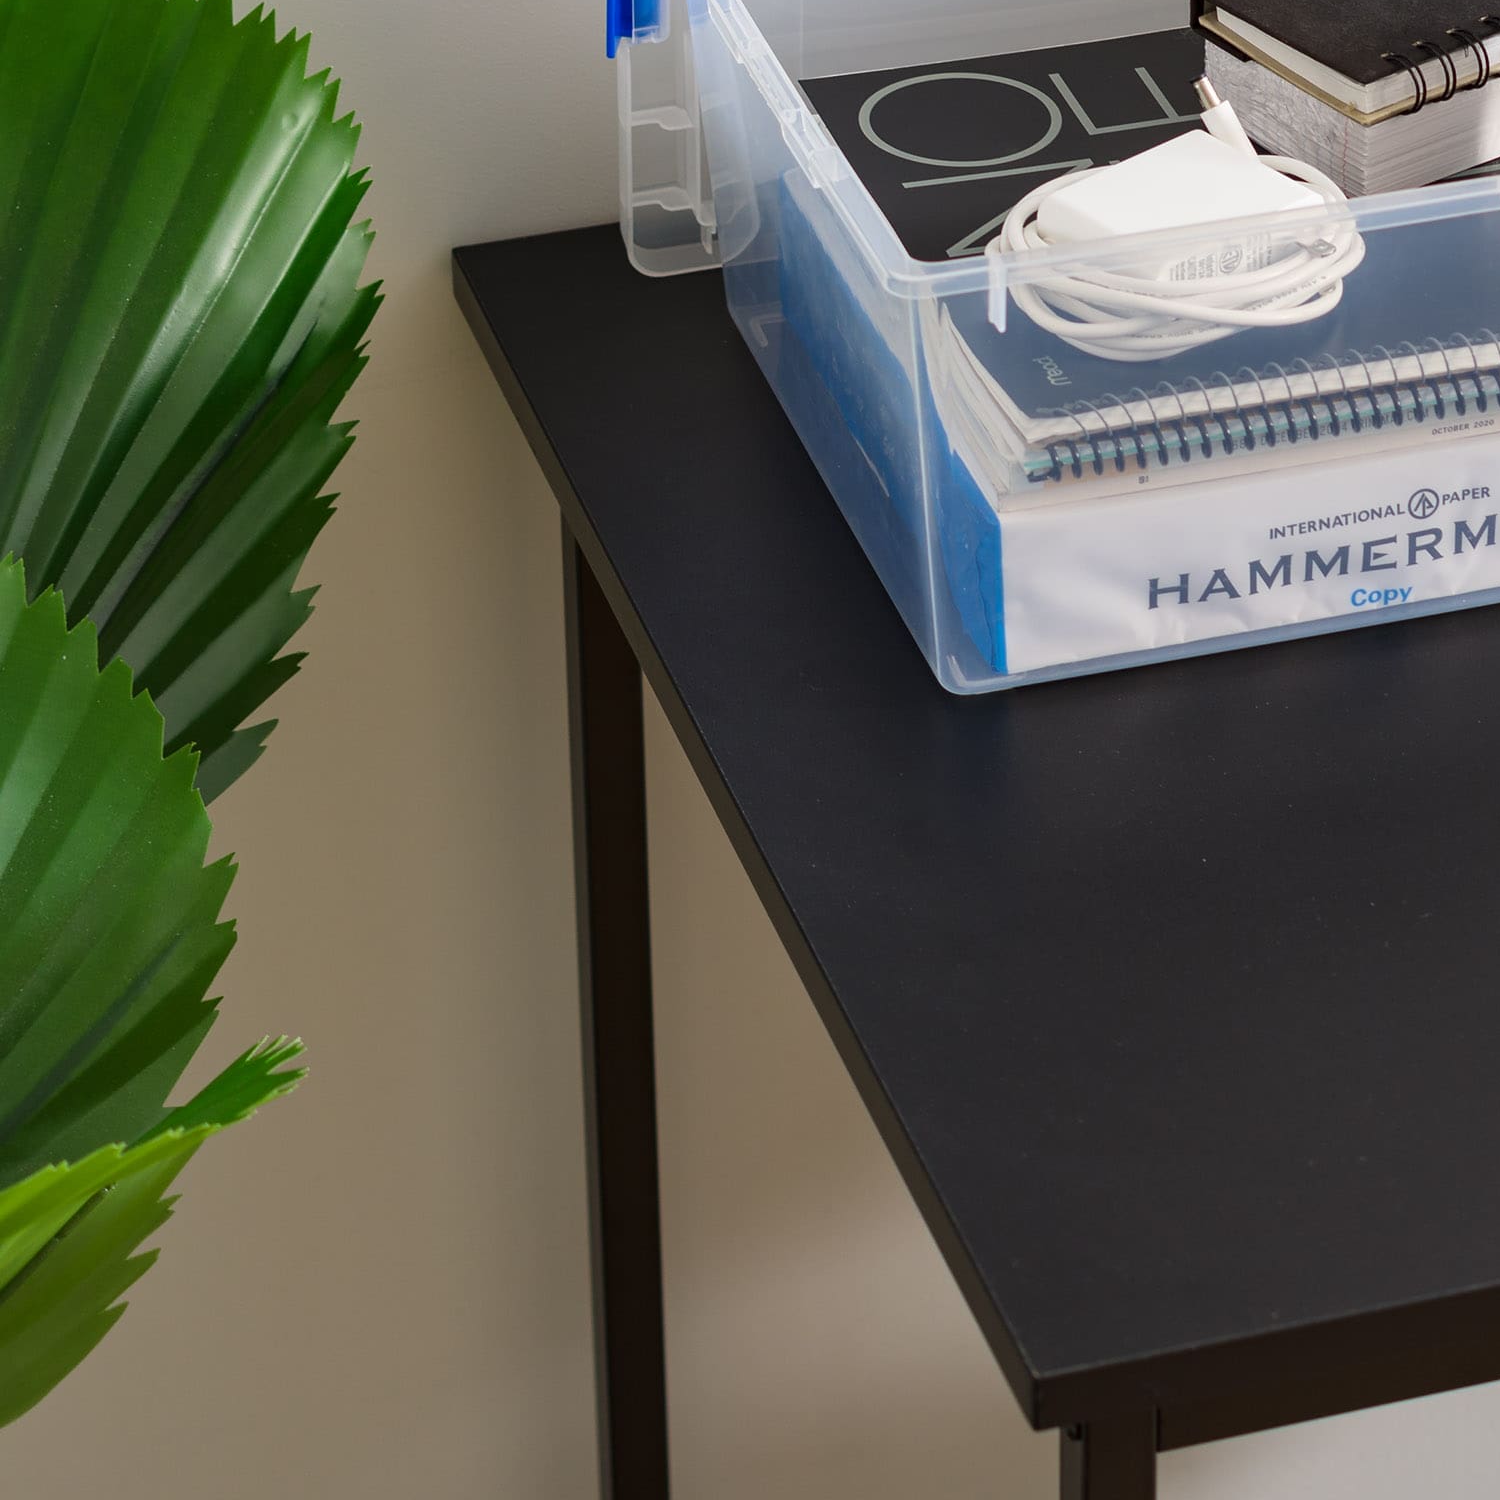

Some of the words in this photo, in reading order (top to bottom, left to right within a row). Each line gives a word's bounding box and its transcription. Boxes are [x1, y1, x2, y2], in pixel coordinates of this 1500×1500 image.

[1431, 423, 1470, 436] OCTOBER
[1473, 419, 1495, 428] 2020
[1269, 503, 1405, 540] INTERNATIONAL
[1442, 486, 1491, 506] PAPER
[1350, 585, 1413, 608] Copy
